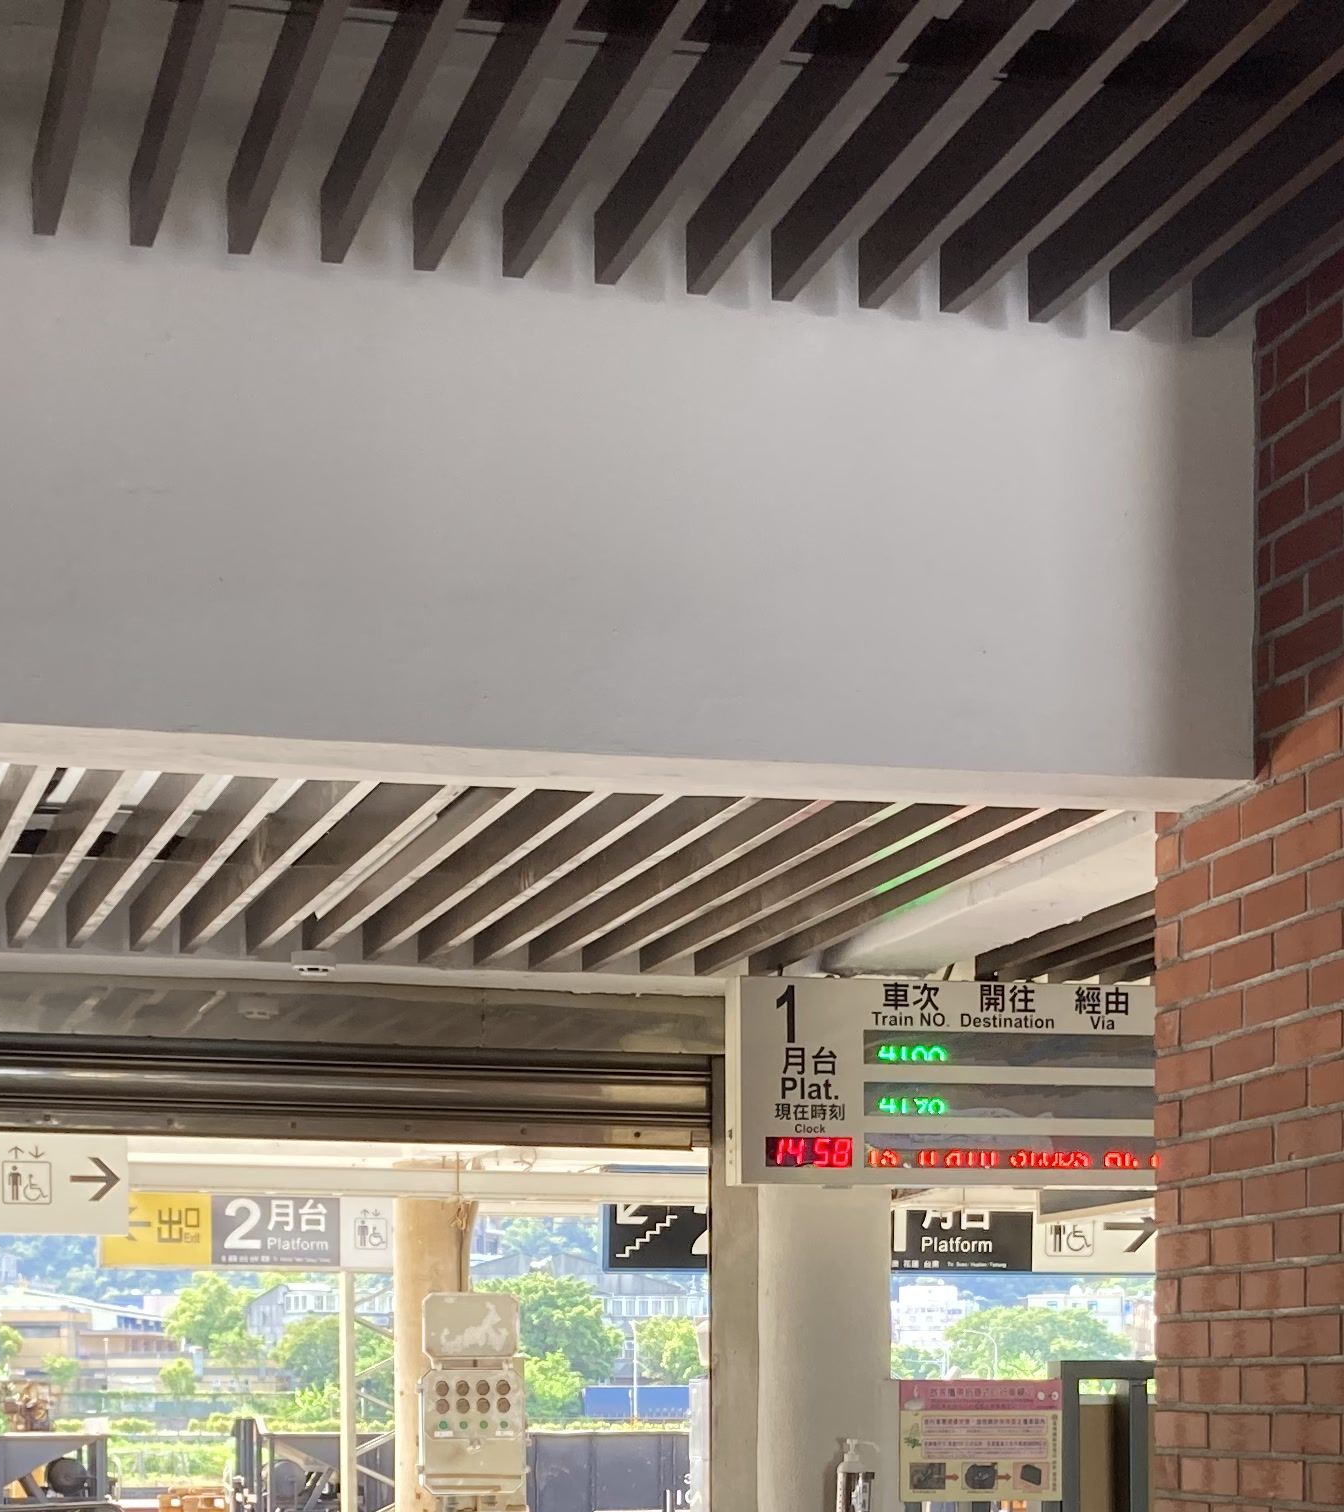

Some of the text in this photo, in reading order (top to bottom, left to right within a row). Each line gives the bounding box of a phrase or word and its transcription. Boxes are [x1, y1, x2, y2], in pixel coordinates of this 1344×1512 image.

[882, 982, 1129, 1016] 車次 開往 經由
[776, 985, 795, 1043] 1
[871, 1012, 1115, 1030] Train NO. Destination Via
[783, 1046, 837, 1075] 月台
[781, 1077, 839, 1100] Plat.
[774, 1103, 845, 1120] 現在時刻
[794, 1124, 826, 1134] Clock
[158, 1207, 200, 1243] 出口
[224, 1199, 261, 1250] 2
[267, 1199, 328, 1232] 月台
[267, 1237, 329, 1251] Platform
[921, 1237, 993, 1252] Platform
